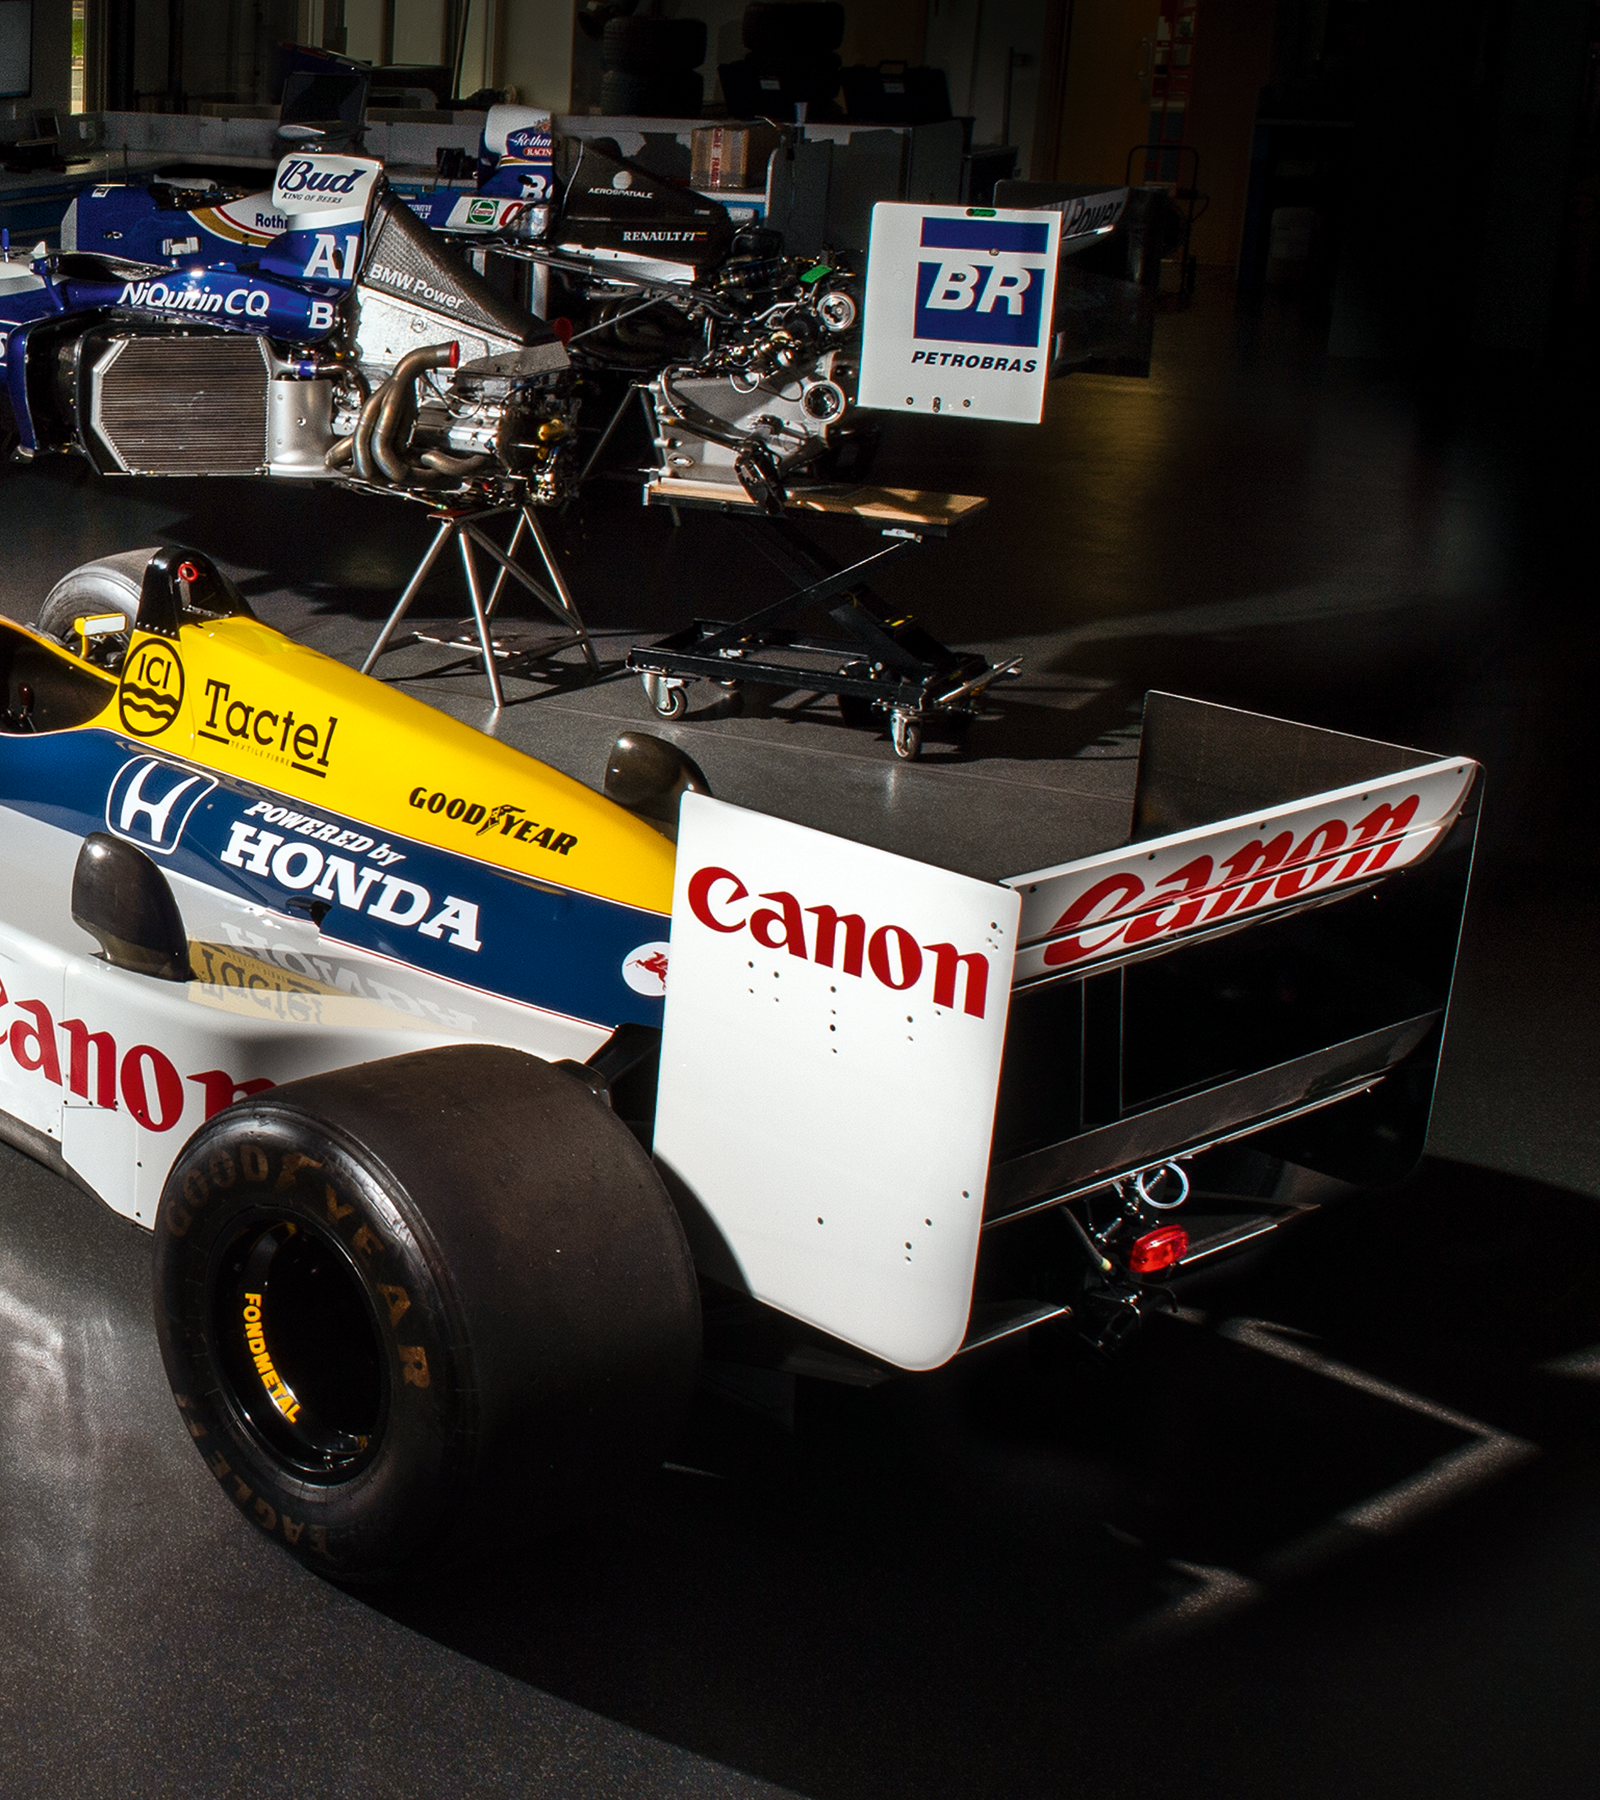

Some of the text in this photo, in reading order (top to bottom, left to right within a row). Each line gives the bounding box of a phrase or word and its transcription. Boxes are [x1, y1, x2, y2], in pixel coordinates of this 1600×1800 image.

[277, 160, 367, 194] Bud
[588, 187, 654, 199] AEROSPATIALE
[281, 192, 302, 201] KING
[316, 196, 342, 204] BEERS
[623, 231, 681, 241] RENAULT
[224, 288, 270, 317] CQ
[369, 263, 464, 309] BMW Power
[925, 262, 1031, 316] BR
[911, 351, 1038, 374] PETROBRAS
[137, 653, 172, 689] ICI
[204, 678, 338, 767] Tactel
[231, 740, 290, 767] TEXTILE FIBRE
[242, 800, 407, 867] POWERED by
[220, 821, 482, 952] HONDA
[1044, 794, 1420, 967] Canon
[688, 866, 988, 1020] Canon
[243, 1291, 301, 1424] FONDMETAL
